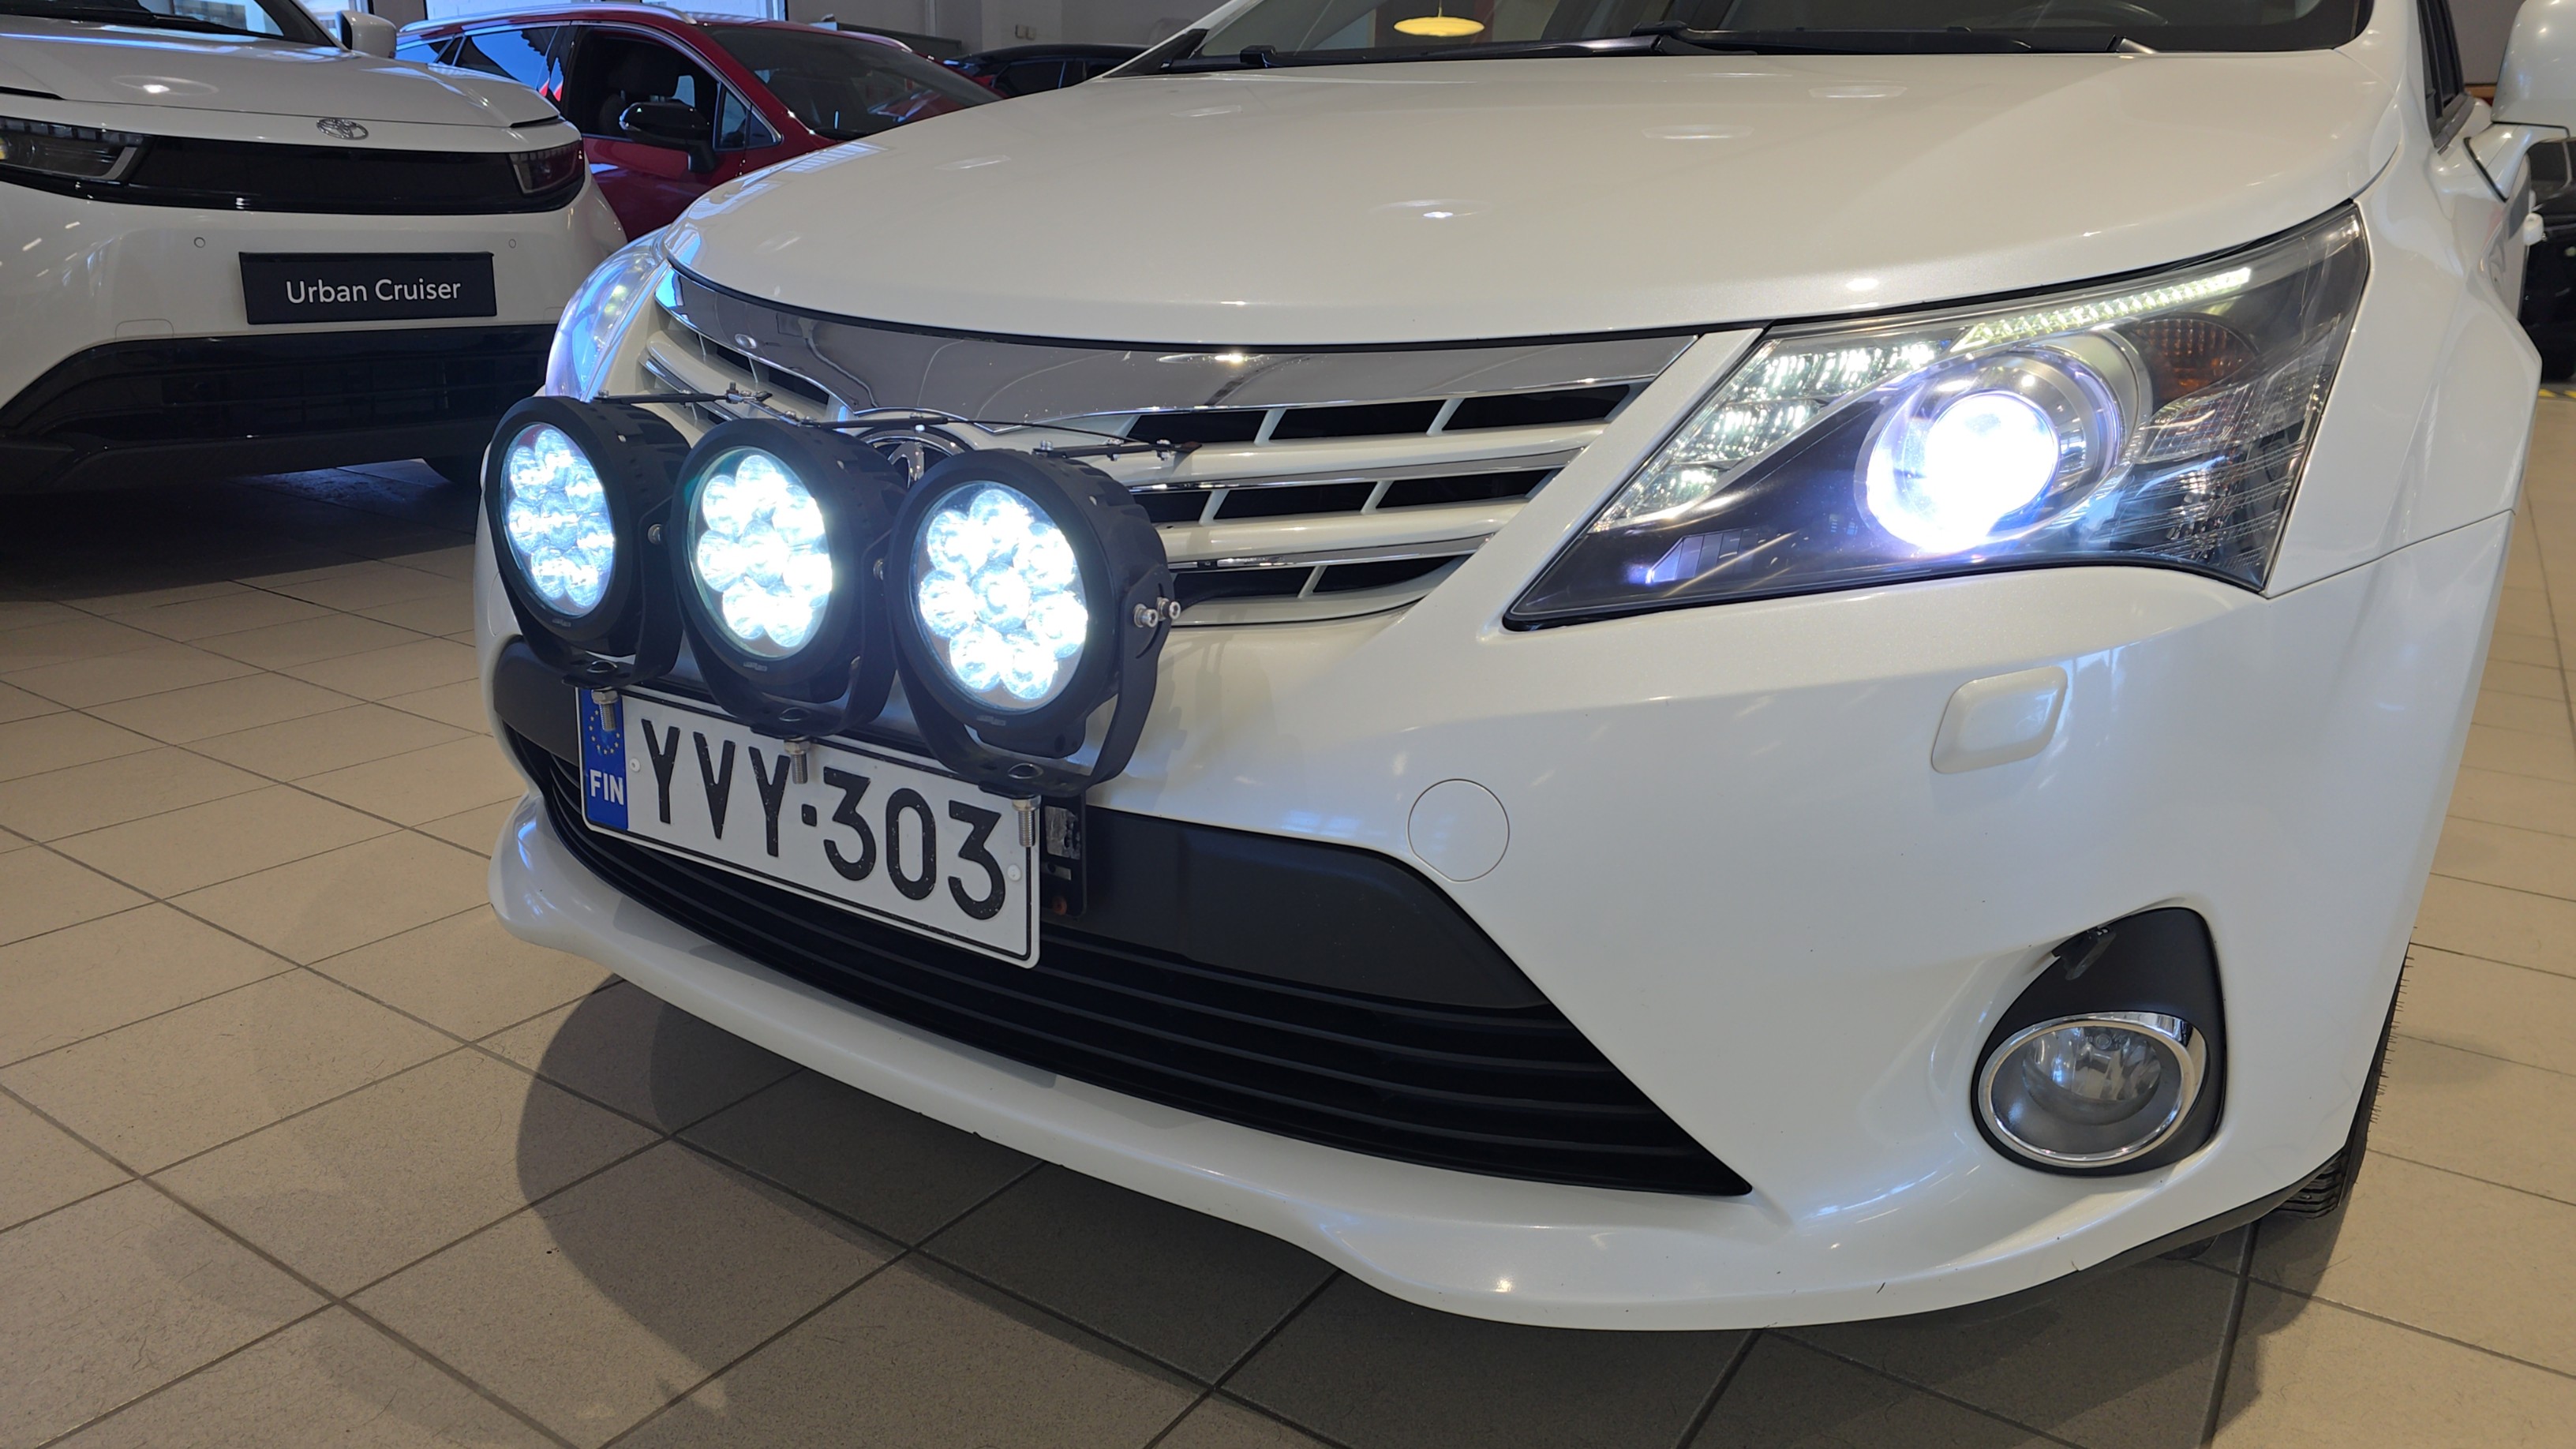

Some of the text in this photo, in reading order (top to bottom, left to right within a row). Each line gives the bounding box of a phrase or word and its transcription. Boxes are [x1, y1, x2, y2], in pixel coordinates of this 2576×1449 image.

[286, 278, 462, 304] Urban Cruiser
[590, 769, 624, 805] FIN
